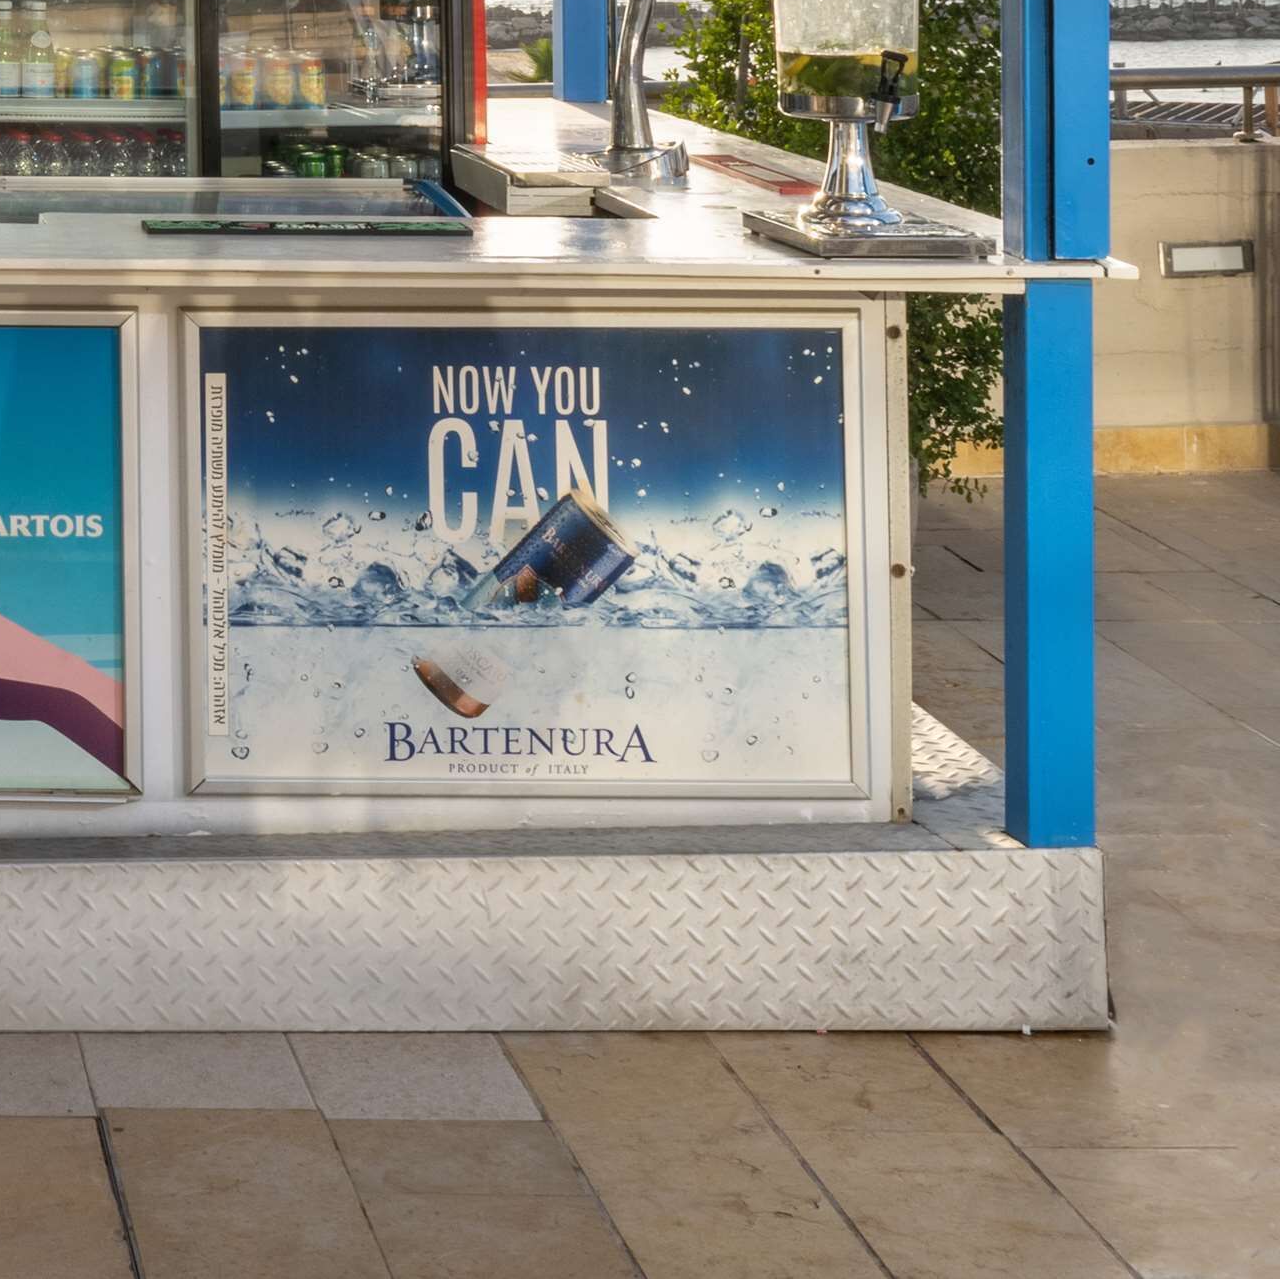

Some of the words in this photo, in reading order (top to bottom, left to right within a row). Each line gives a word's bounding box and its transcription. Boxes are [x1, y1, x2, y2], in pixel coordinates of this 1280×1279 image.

[211, 385, 223, 432] מופרזת
[432, 365, 517, 415] NOW
[530, 366, 601, 416] YOU
[211, 436, 224, 480] משתיה
[428, 417, 610, 546] CAN
[212, 484, 225, 530] להימנע
[210, 533, 226, 573] מומלץ
[212, 587, 226, 639] אלכוהול
[212, 642, 226, 672] מכיל
[384, 721, 658, 764] BARTENURA
[448, 762, 520, 775] PRODUCT
[524, 763, 540, 776] of
[548, 763, 590, 775] ITALY
